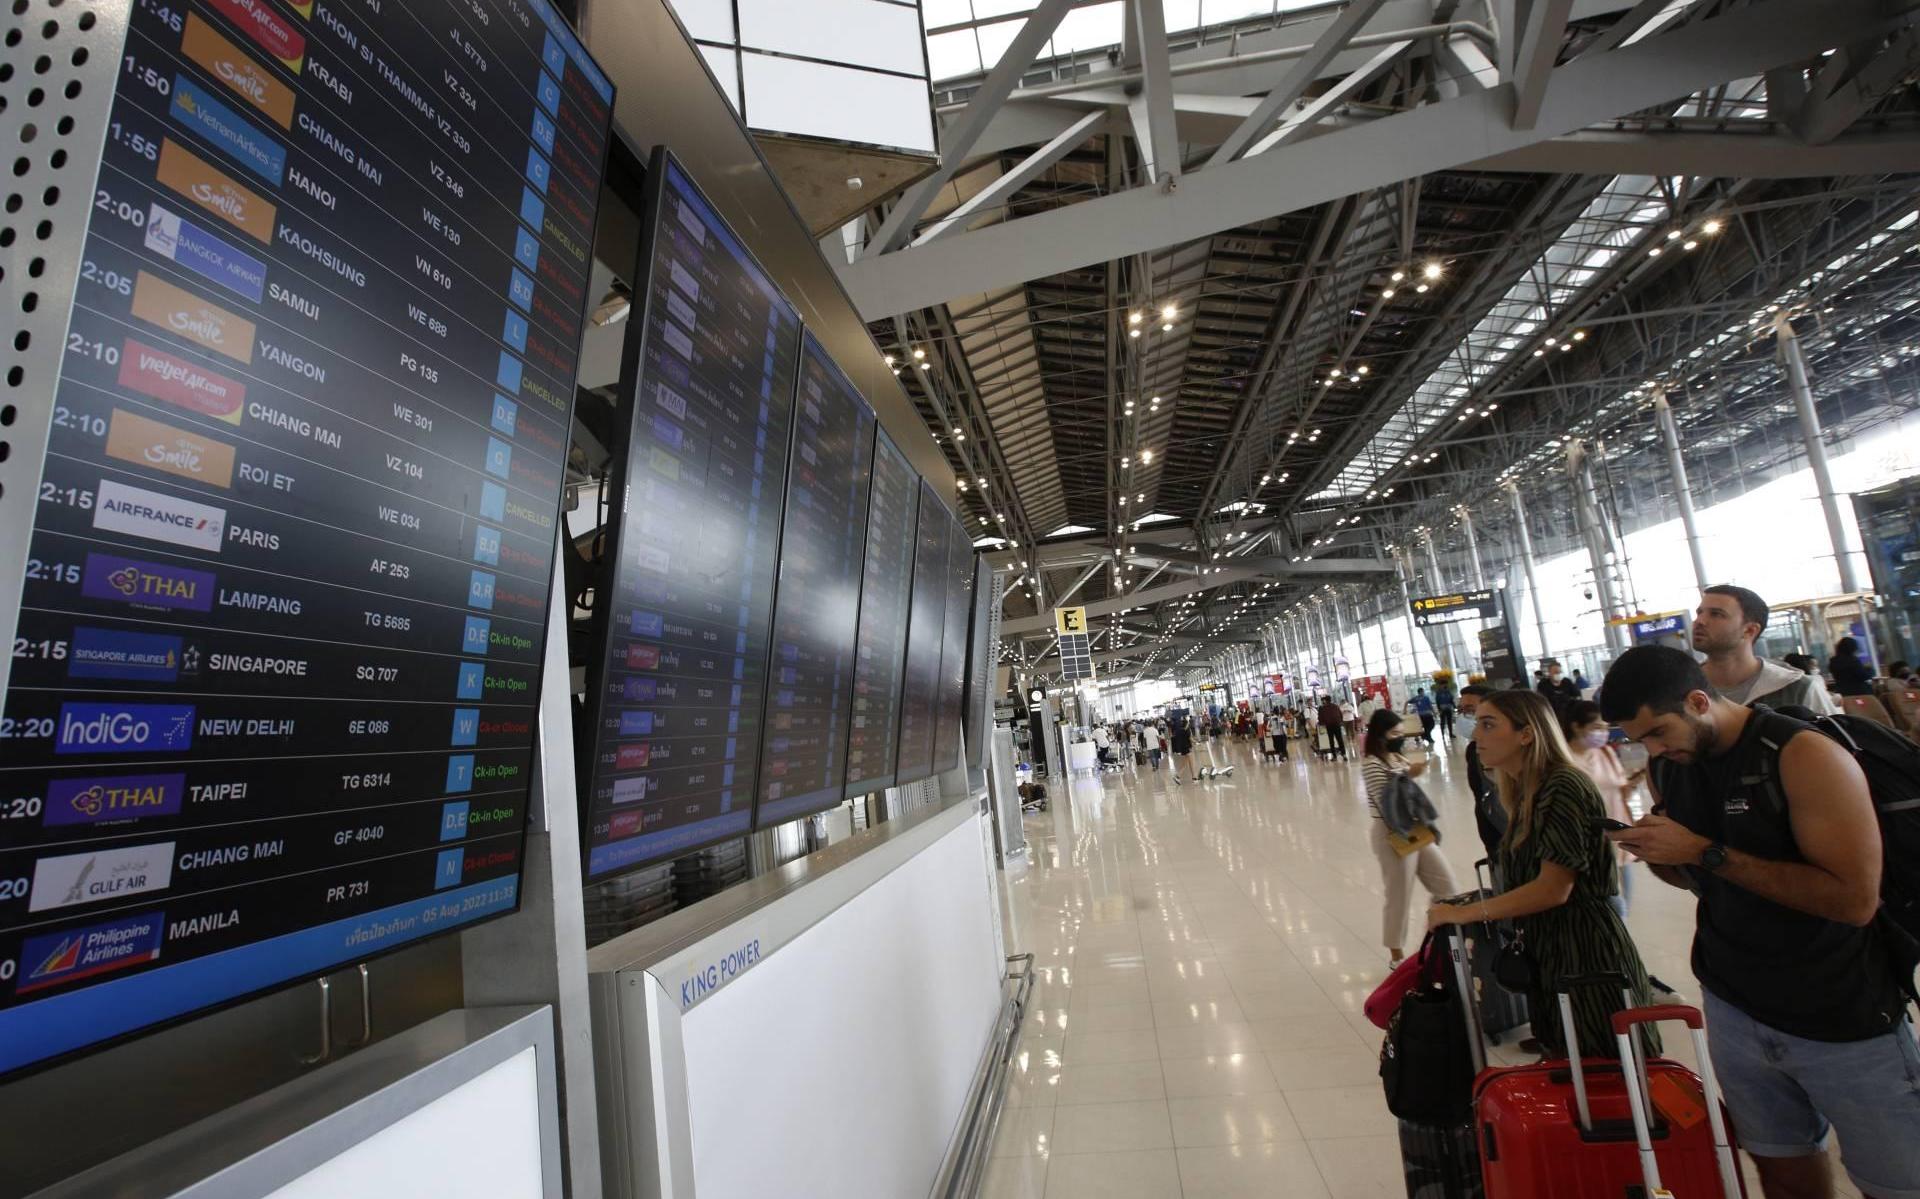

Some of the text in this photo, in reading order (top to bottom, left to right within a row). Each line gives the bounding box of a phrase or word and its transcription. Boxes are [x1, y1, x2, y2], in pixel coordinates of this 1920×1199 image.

[124, 55, 171, 96] 1:50
[214, 60, 266, 104] Smile
[444, 69, 458, 92] VZ
[459, 87, 477, 111] 324
[307, 57, 353, 104] KRABI
[430, 160, 444, 183] VZ
[316, 4, 358, 49] KHON
[360, 44, 374, 65] SI
[437, 114, 451, 138] VZ
[452, 131, 470, 154] 330
[544, 218, 585, 263] CANCELLED
[111, 123, 157, 161] 1:55
[299, 112, 354, 164] CHIANG
[358, 157, 382, 187] MAI
[422, 208, 442, 232] WE
[443, 224, 461, 246] 130
[95, 190, 145, 228] 2:00
[191, 183, 245, 222] Smile
[178, 235, 224, 268] BANGKOK
[288, 167, 520, 340] HANOI VN 610 L
[81, 261, 132, 296] 2:05
[168, 311, 225, 345] Smile
[268, 284, 320, 320] SAMUI
[400, 352, 418, 372] PG
[420, 362, 438, 384] 135
[278, 224, 566, 412] KAOHSIUNG WE 688 CANCELLED
[67, 333, 120, 366] 2:10
[258, 340, 326, 384] YANGON
[393, 402, 412, 424] WE
[414, 412, 433, 433] 301
[54, 407, 106, 437] 2:10
[144, 444, 202, 473] Smile
[249, 402, 551, 528] CHIANG MAI VZ 104 CANCELLED
[40, 482, 94, 510] 2:15
[239, 462, 270, 486] ROI
[272, 474, 296, 493] ET
[378, 504, 398, 525] WE
[400, 512, 420, 530] 034
[26, 560, 80, 584] 2:15
[229, 526, 280, 550] PARIS
[370, 558, 388, 574] AF
[390, 562, 410, 580] 253
[141, 574, 196, 600] THAI
[219, 590, 301, 616] LAMPANG
[364, 611, 382, 627] TG
[384, 614, 410, 632] 5685
[512, 636, 532, 650] Open
[1064, 610, 1078, 630] E
[12, 638, 68, 660] 2:15
[208, 654, 307, 676] SINGAPORE
[356, 666, 374, 681] SQ
[378, 668, 398, 682] 707
[467, 673, 476, 688] K
[508, 679, 528, 692] Open
[62, 712, 150, 745] IndiGo
[200, 720, 242, 736] NEW
[246, 720, 294, 736] DELHI
[349, 720, 366, 734] 6E
[368, 720, 390, 734] 086
[460, 720, 472, 734] W
[106, 786, 165, 810] THAI
[190, 783, 248, 803] TAIPEI
[342, 776, 360, 790] TG
[363, 772, 392, 788] 6314
[457, 766, 465, 781] T
[498, 766, 518, 777] Open
[179, 845, 250, 871] CHIANG
[253, 840, 284, 860] MAI
[334, 830, 353, 846] GF
[355, 825, 384, 842] 4040
[494, 808, 514, 820] Open
[89, 875, 147, 896] GULF AIR
[169, 910, 240, 940] MANILA
[327, 886, 346, 903] PR
[349, 881, 369, 898] 731
[446, 860, 456, 875] N
[423, 908, 437, 924] 05
[439, 904, 460, 918] Aug
[464, 894, 487, 912] 2022
[82, 943, 134, 965] Airlines
[87, 924, 150, 948] Philippine
[682, 940, 760, 1006] KING POWER
